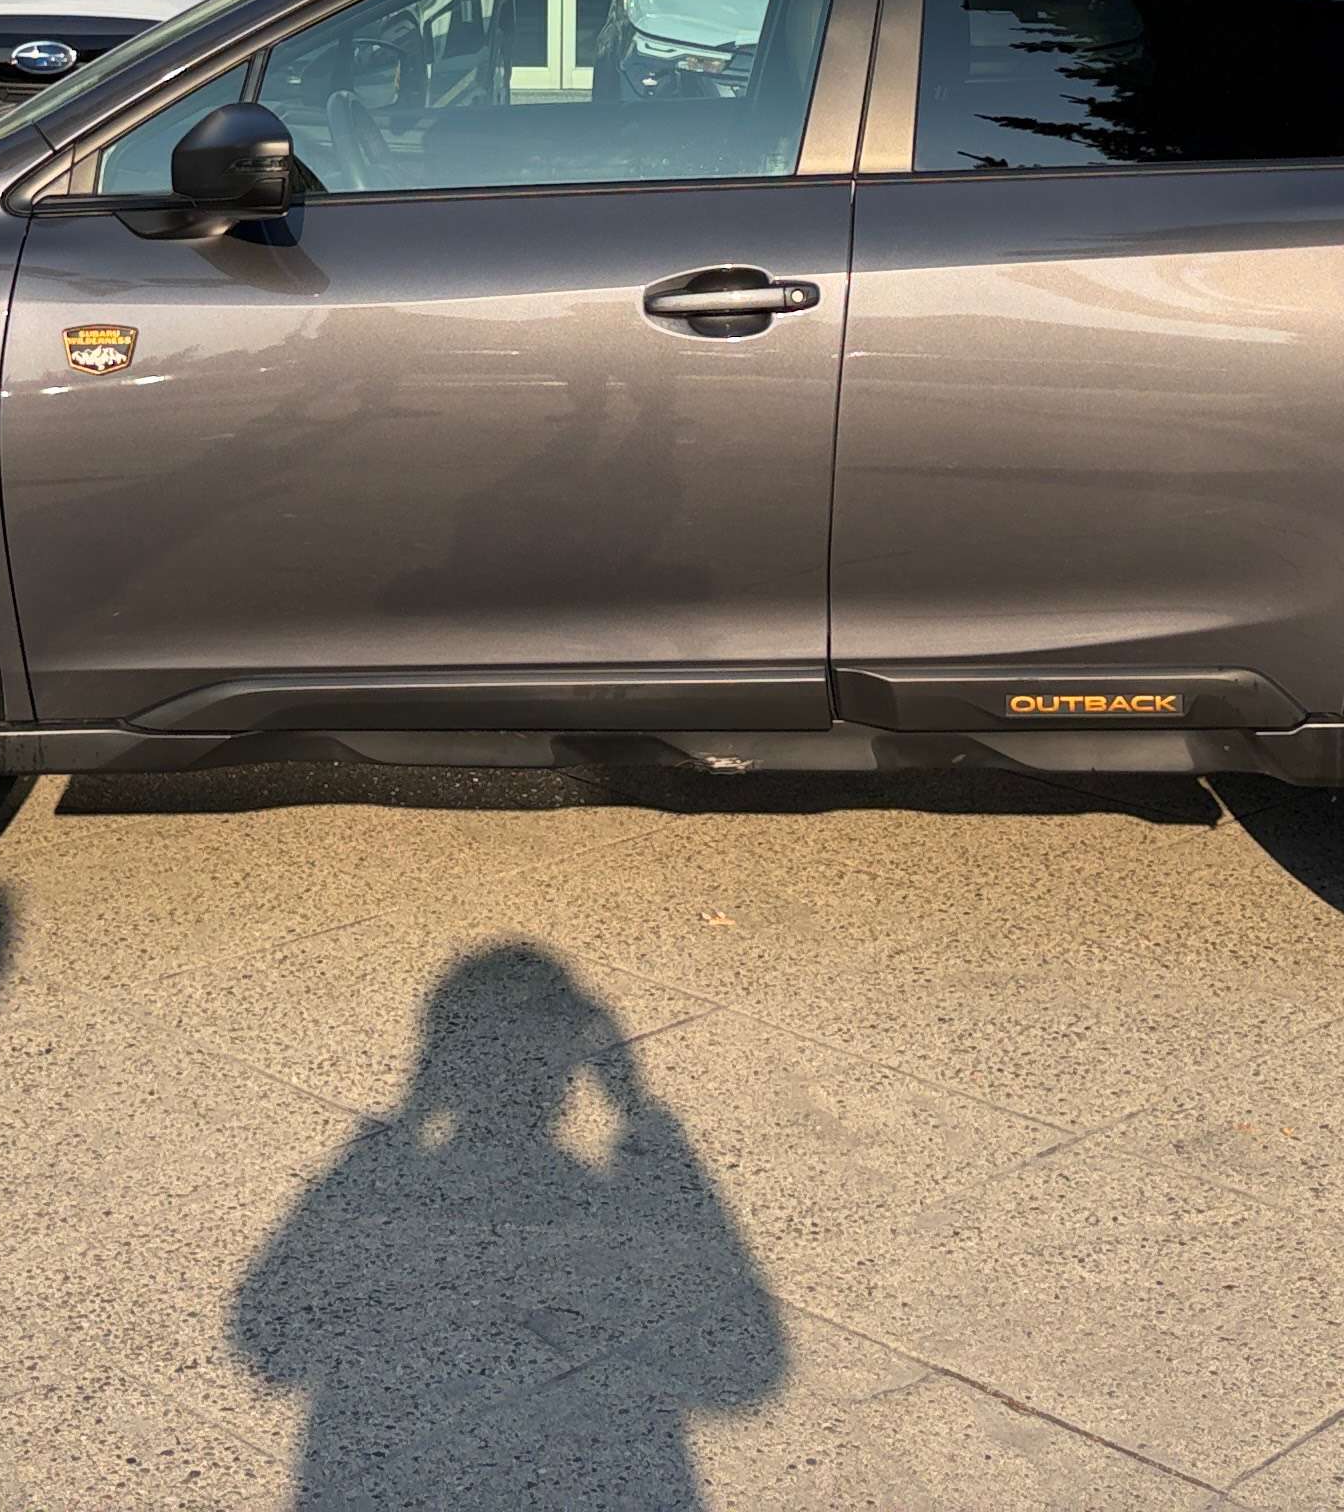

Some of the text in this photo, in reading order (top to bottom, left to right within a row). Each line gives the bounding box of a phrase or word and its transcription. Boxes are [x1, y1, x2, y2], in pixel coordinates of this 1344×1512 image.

[78, 330, 121, 338] SUBARU
[66, 336, 132, 345] WILDERNESS
[1009, 694, 1177, 713] OUTBACK
